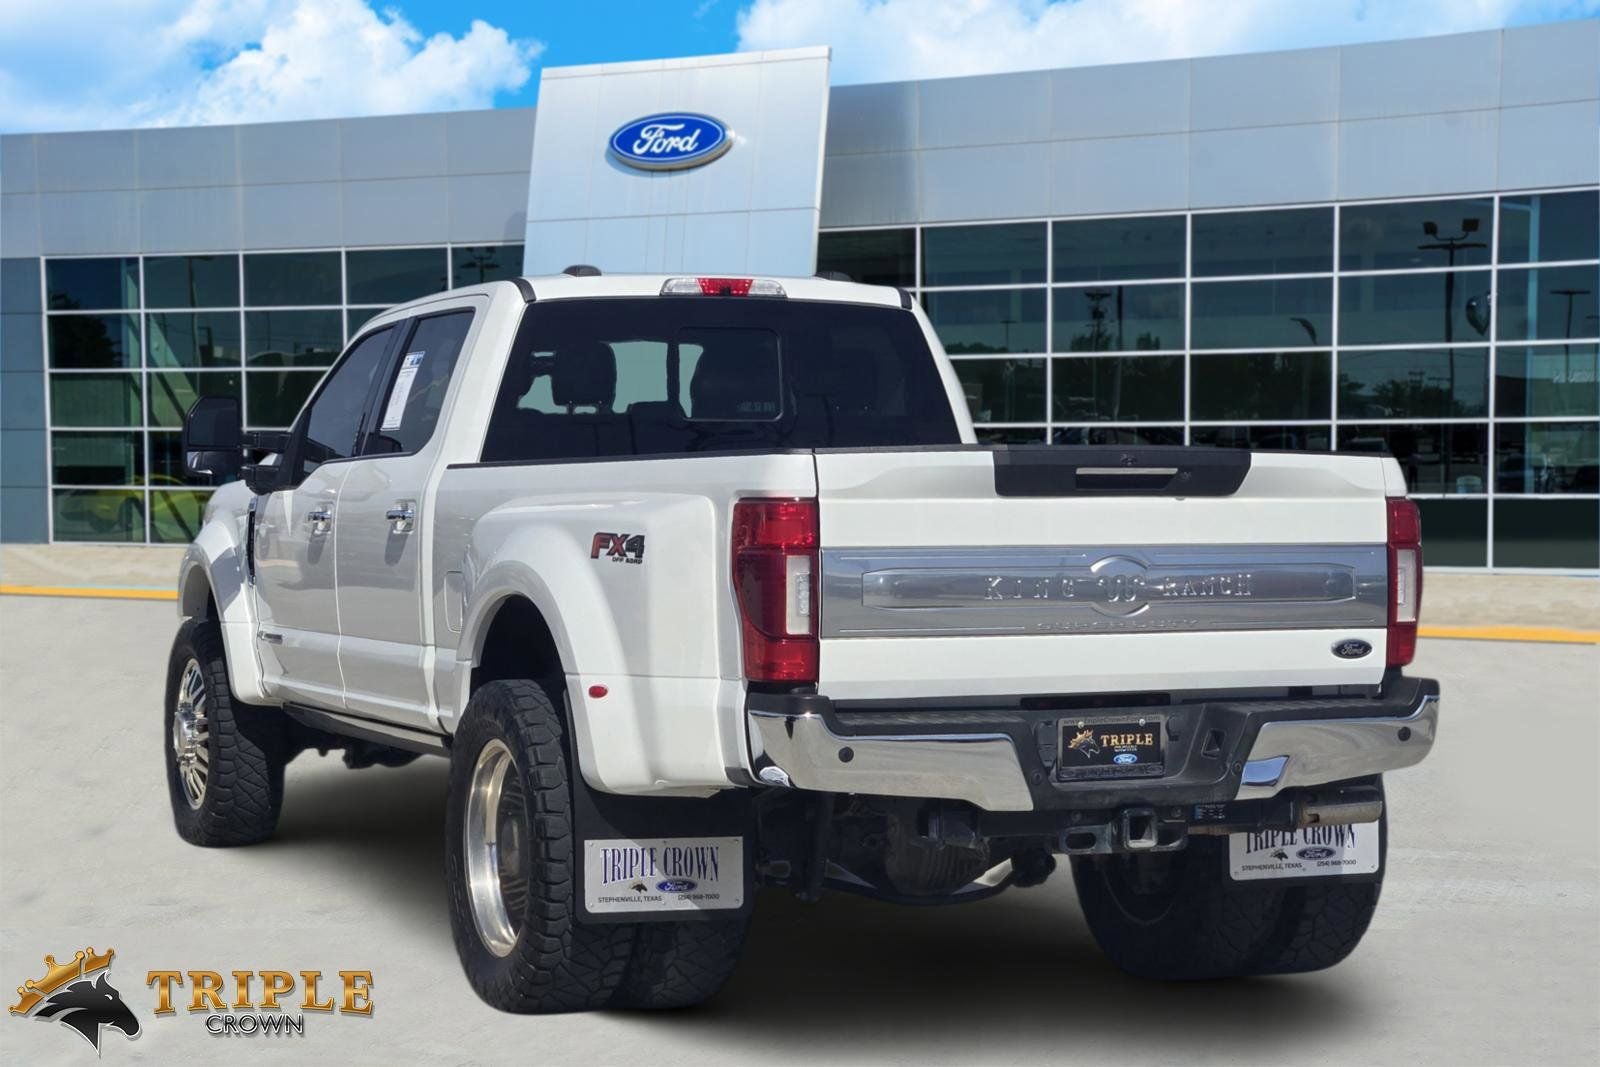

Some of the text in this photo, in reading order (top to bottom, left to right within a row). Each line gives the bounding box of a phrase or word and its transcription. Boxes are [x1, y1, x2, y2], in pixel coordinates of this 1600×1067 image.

[632, 123, 702, 155] Ford
[591, 532, 646, 559] FX4
[984, 574, 1252, 600] KING RANCH
[1341, 643, 1364, 655] Ford
[1100, 733, 1153, 748] TRIPLE
[1303, 823, 1356, 849] CROWN
[1304, 848, 1327, 859] Ford
[600, 846, 719, 885] TRIPLE CROWN
[1241, 861, 1303, 871] STEPHENVILLE, TEXAS
[664, 881, 690, 892] Ford
[598, 895, 663, 904] STEPHENVILLE, TEXAS
